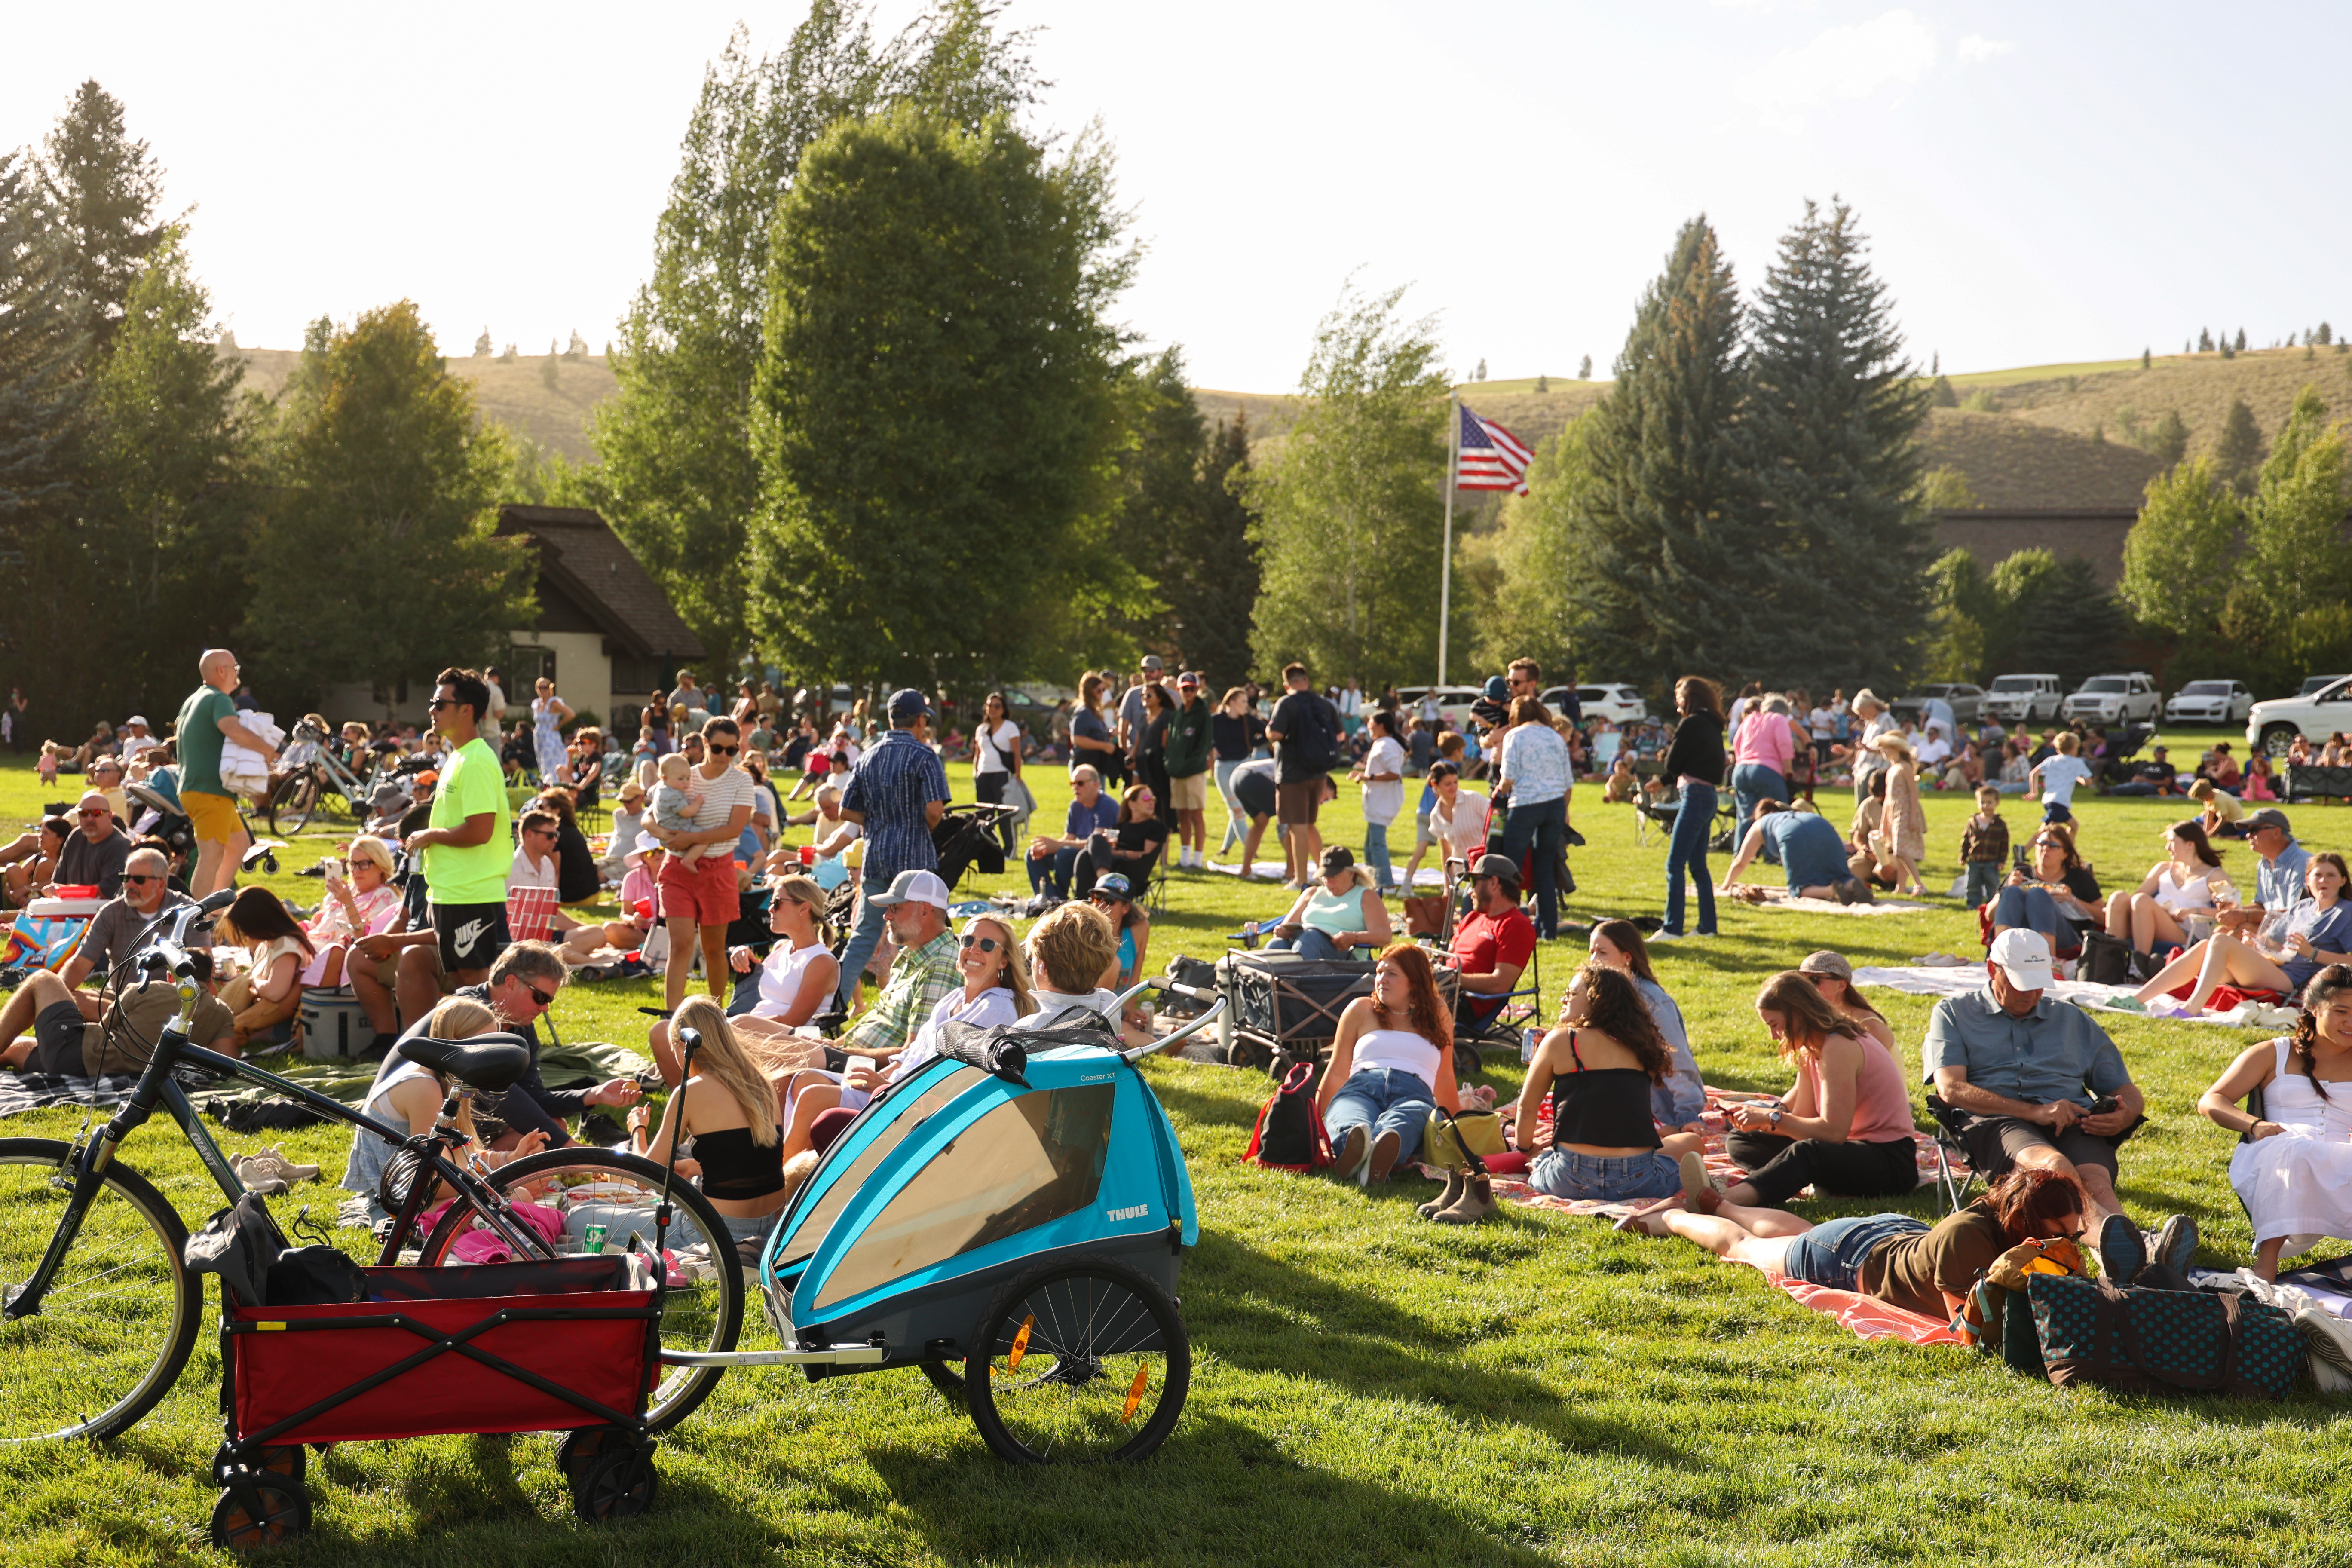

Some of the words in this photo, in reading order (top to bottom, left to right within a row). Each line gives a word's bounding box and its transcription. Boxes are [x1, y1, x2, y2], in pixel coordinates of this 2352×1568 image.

[454, 918, 482, 945] NIKE
[238, 1072, 277, 1089] CYPRESS
[190, 1133, 218, 1167] GIANT
[471, 1200, 484, 1211] GIANT
[1107, 1204, 1148, 1222] THULE
[65, 1208, 80, 1226] NEX
[447, 1209, 467, 1234] GIANT
